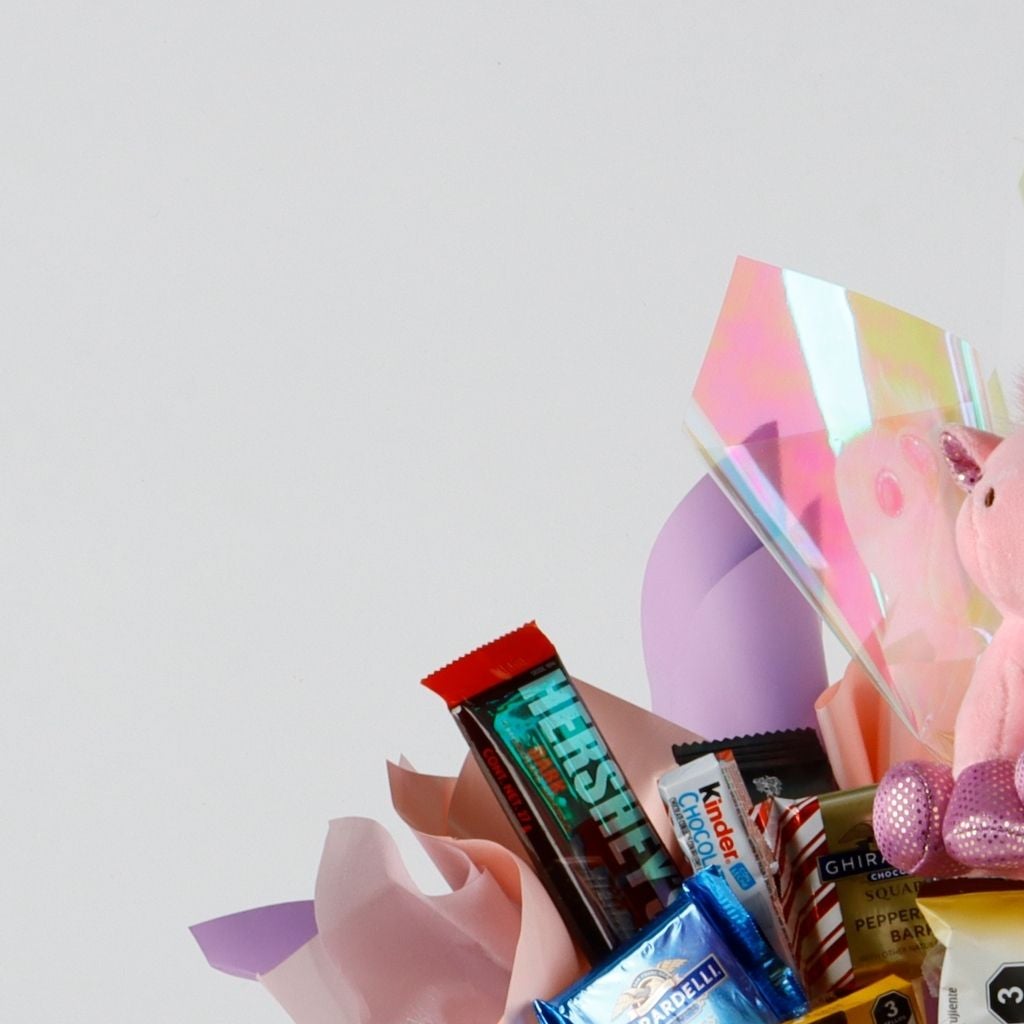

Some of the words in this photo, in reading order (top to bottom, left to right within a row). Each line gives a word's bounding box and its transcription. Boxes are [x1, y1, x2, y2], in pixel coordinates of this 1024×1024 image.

[679, 791, 721, 870] CHOCOL
[699, 781, 740, 862] Kinder
[855, 909, 920, 931] PEPPER
[997, 986, 1024, 1004] 3
[884, 1000, 898, 1018] 3
